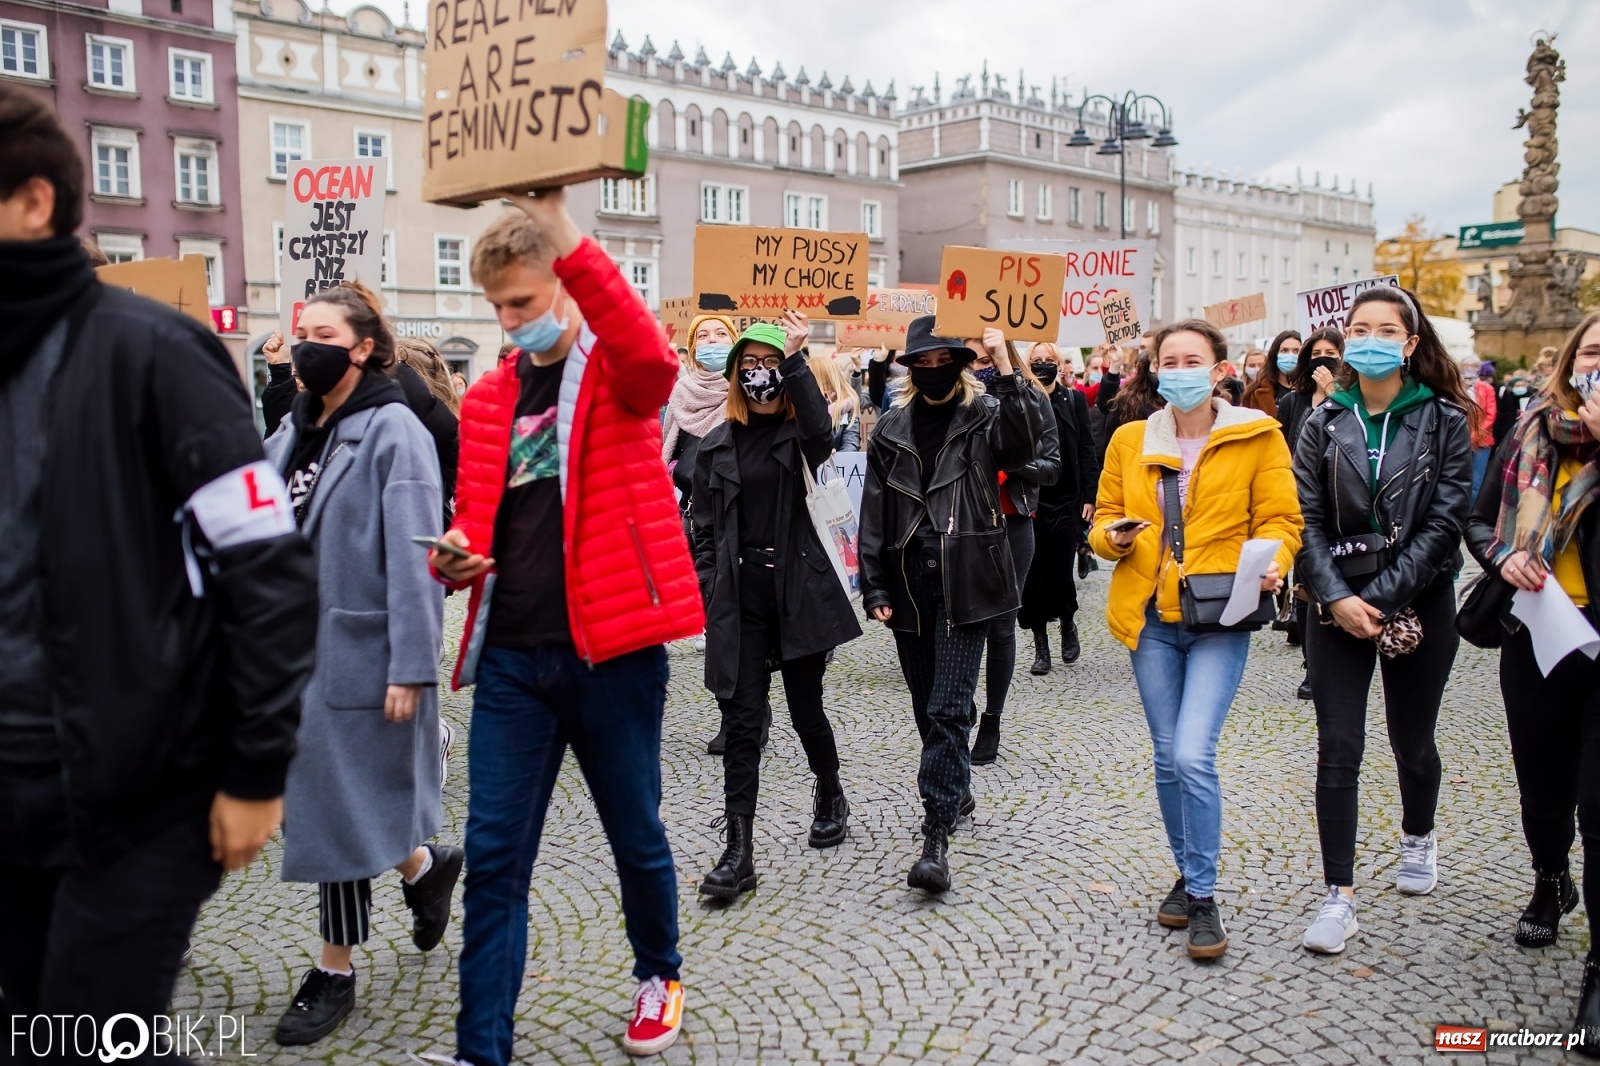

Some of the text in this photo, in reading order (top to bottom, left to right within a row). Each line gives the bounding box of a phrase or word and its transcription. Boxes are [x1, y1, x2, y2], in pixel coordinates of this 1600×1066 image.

[435, 0, 509, 51] REAL
[456, 35, 536, 107] ARE
[427, 79, 602, 169] FEMINISTS
[293, 165, 374, 203] OCEAN
[310, 200, 356, 232] JEST
[288, 229, 369, 261] CZYSTSZY
[755, 235, 858, 265] MY PUSSY
[752, 263, 855, 291] MY CHOICE
[999, 255, 1042, 288] PIS
[1065, 249, 1138, 278] RONIE
[979, 289, 1048, 330] SUS
[1103, 296, 1131, 316] MYŚLĘ
[1306, 286, 1351, 318] MOJE
[1107, 321, 1142, 345] DECYDUJĘ
